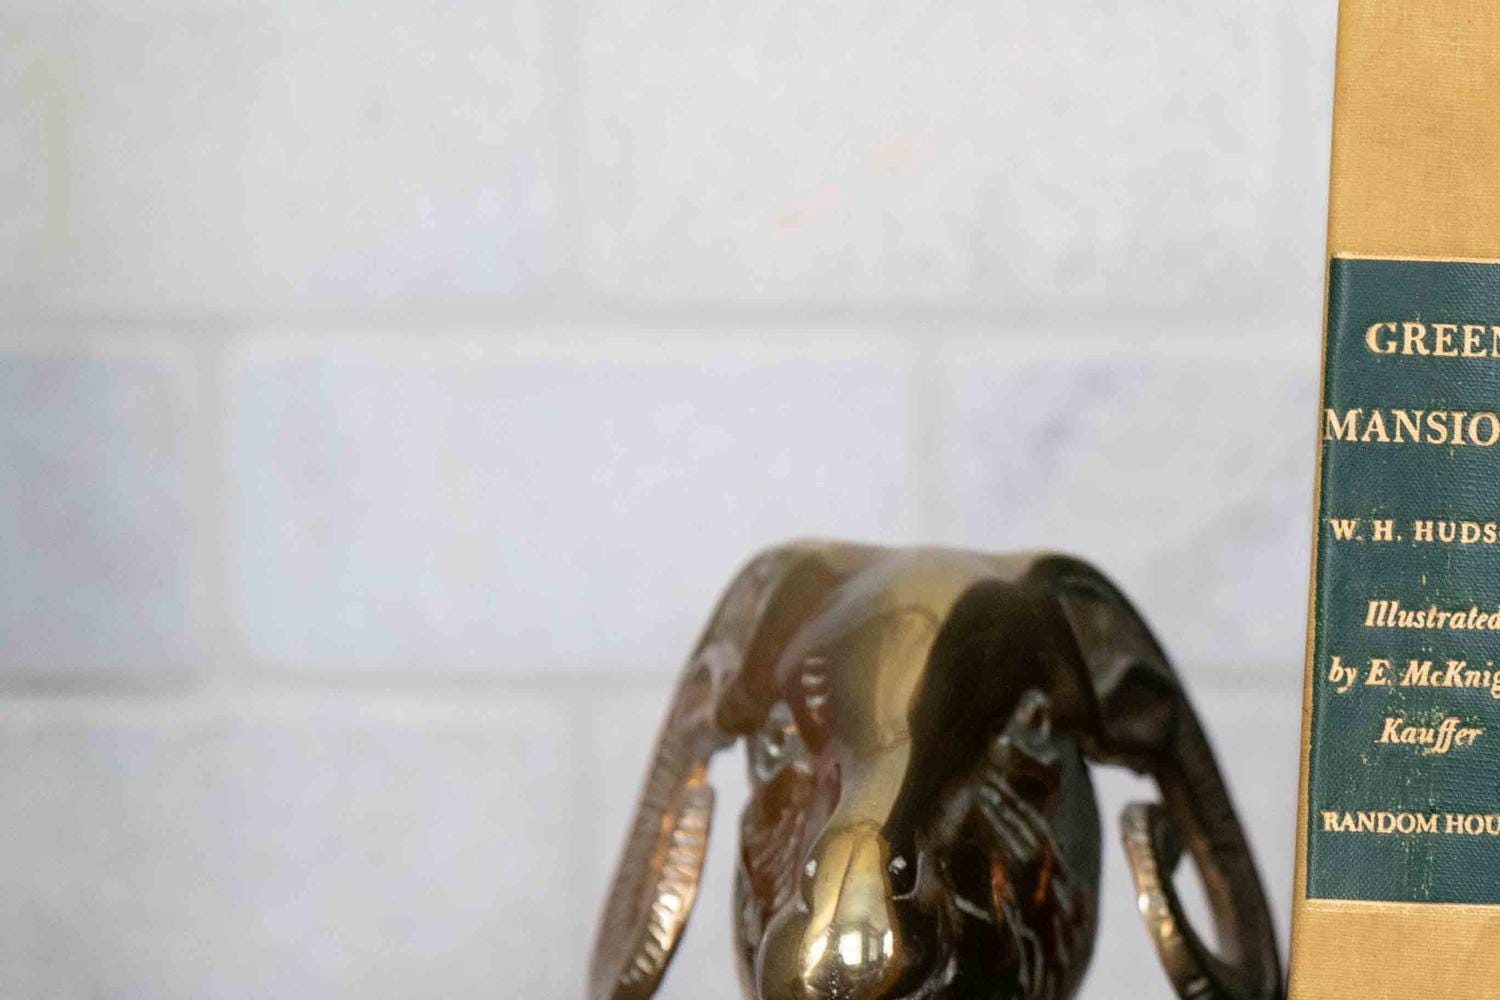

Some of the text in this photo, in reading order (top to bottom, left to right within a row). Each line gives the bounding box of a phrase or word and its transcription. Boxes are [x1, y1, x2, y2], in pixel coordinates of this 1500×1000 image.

[1373, 519, 1402, 542] H.
[1328, 656, 1357, 693] by
[1365, 658, 1392, 686] E.
[1375, 717, 1483, 753] Kauffer
[1321, 810, 1438, 834] RANDOM
